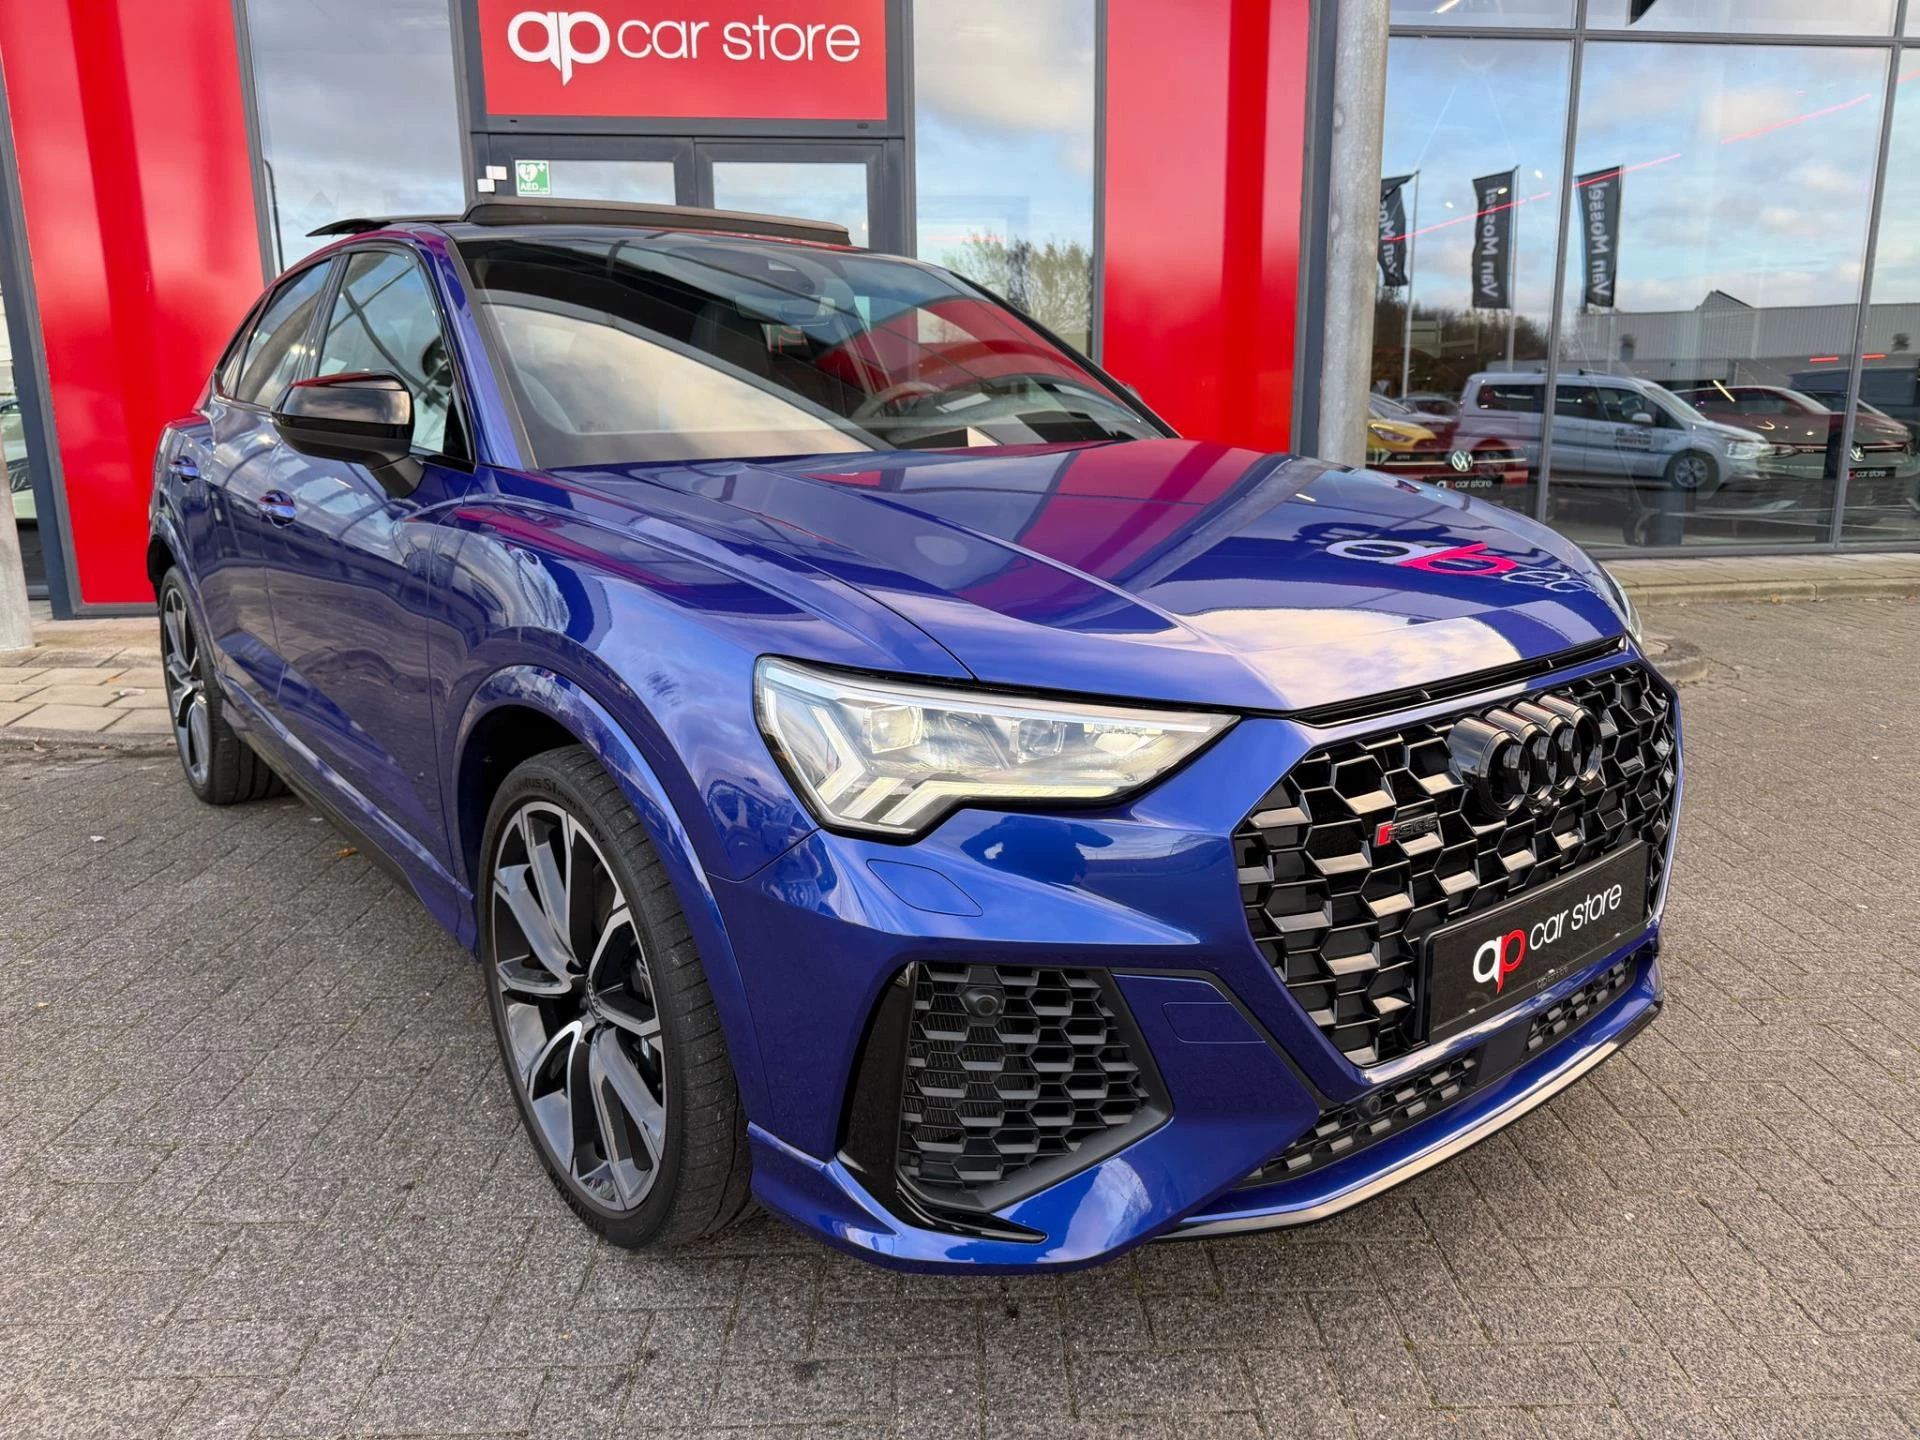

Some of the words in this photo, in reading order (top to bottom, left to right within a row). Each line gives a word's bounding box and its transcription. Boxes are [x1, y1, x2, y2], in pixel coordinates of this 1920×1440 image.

[617, 19, 709, 59] car
[722, 14, 861, 62] store
[520, 182, 539, 191] AED
[1529, 910, 1569, 951] car
[1570, 883, 1622, 931] store
